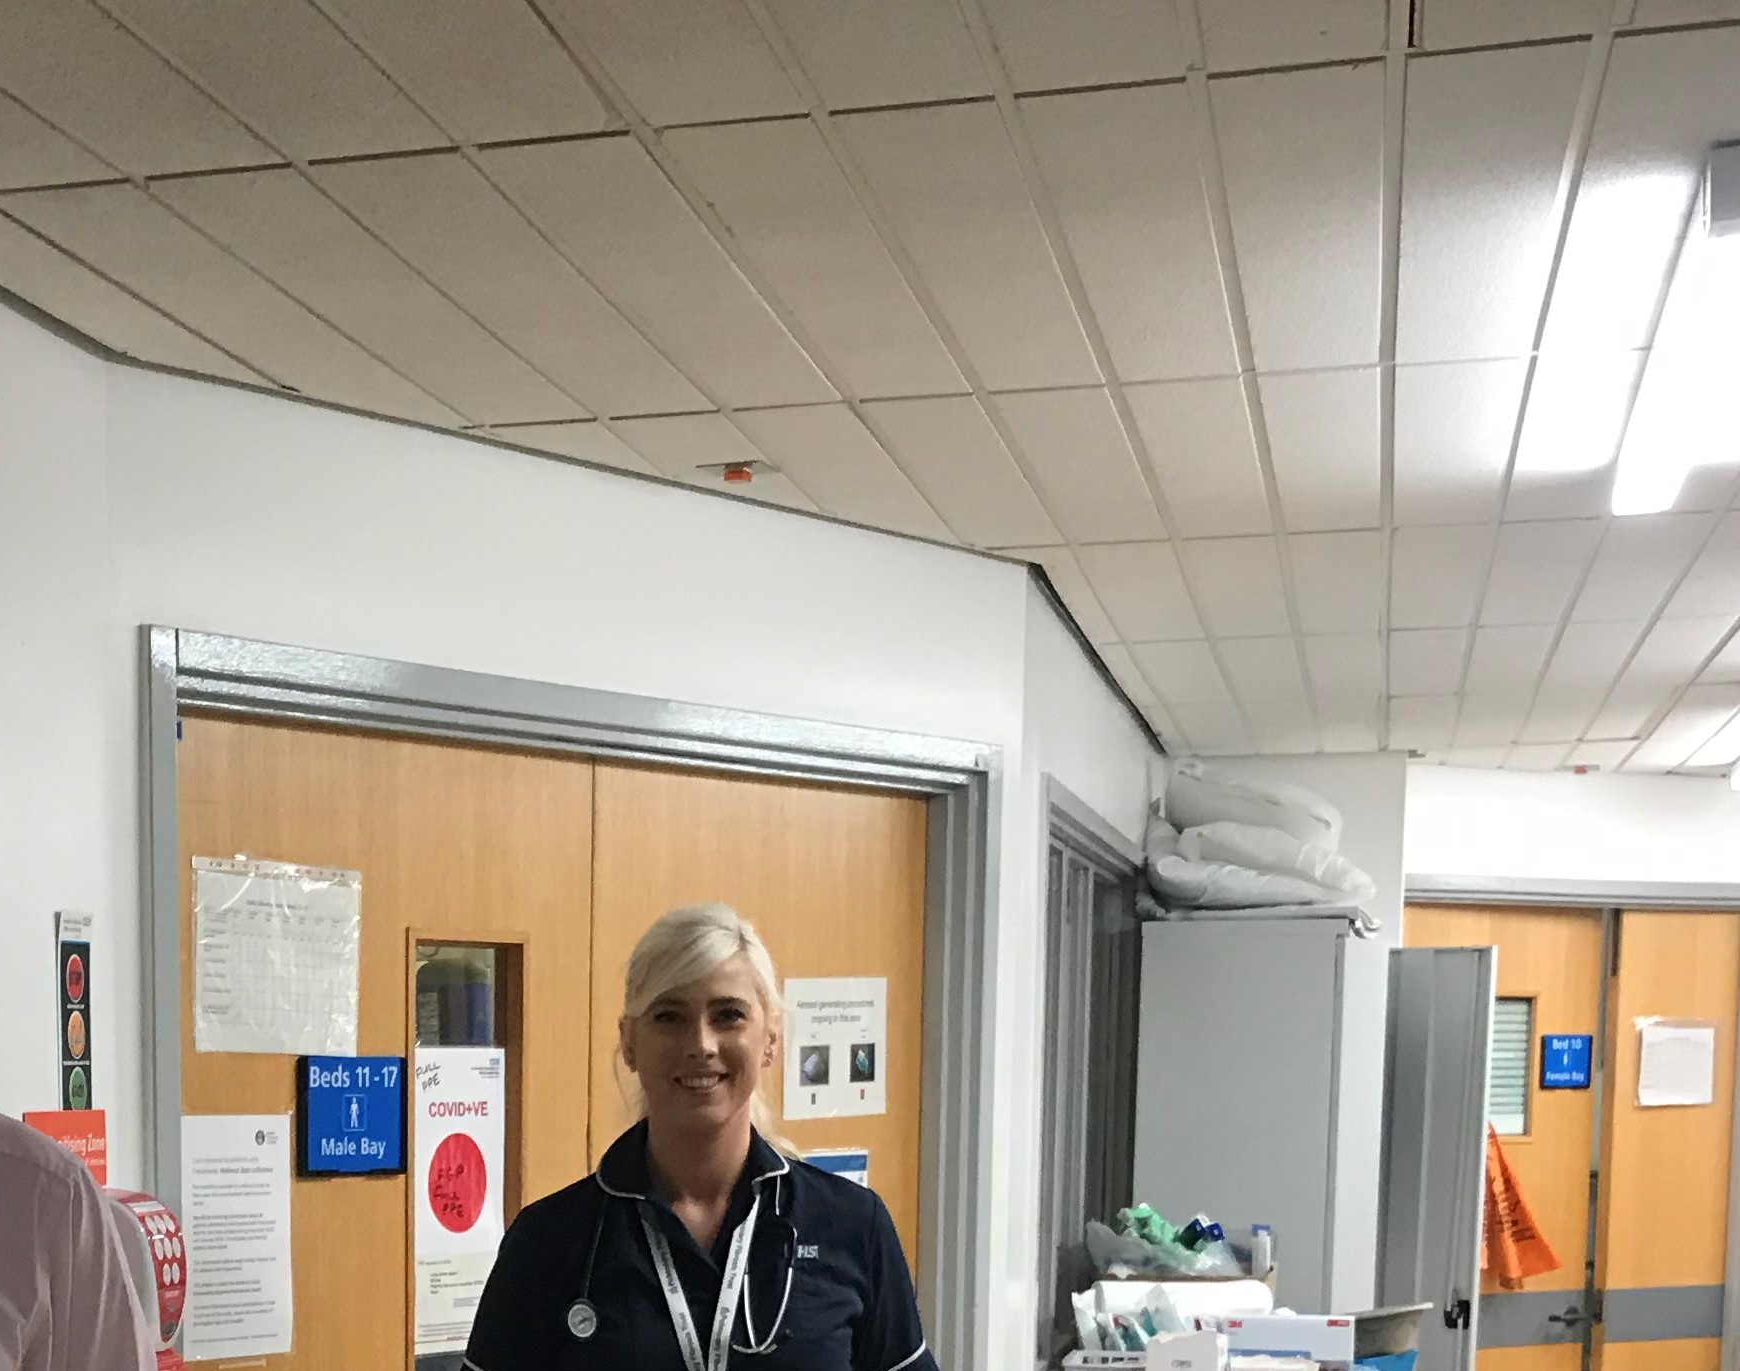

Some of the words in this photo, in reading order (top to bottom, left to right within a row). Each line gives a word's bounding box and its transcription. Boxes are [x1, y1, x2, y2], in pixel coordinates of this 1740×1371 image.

[1552, 1038, 1569, 1050] Bed
[310, 1066, 350, 1088] Beds
[421, 1072, 441, 1093] PPE
[428, 1101, 488, 1118] COVID+VE
[321, 1138, 356, 1156] Male
[360, 1138, 387, 1160] Bay
